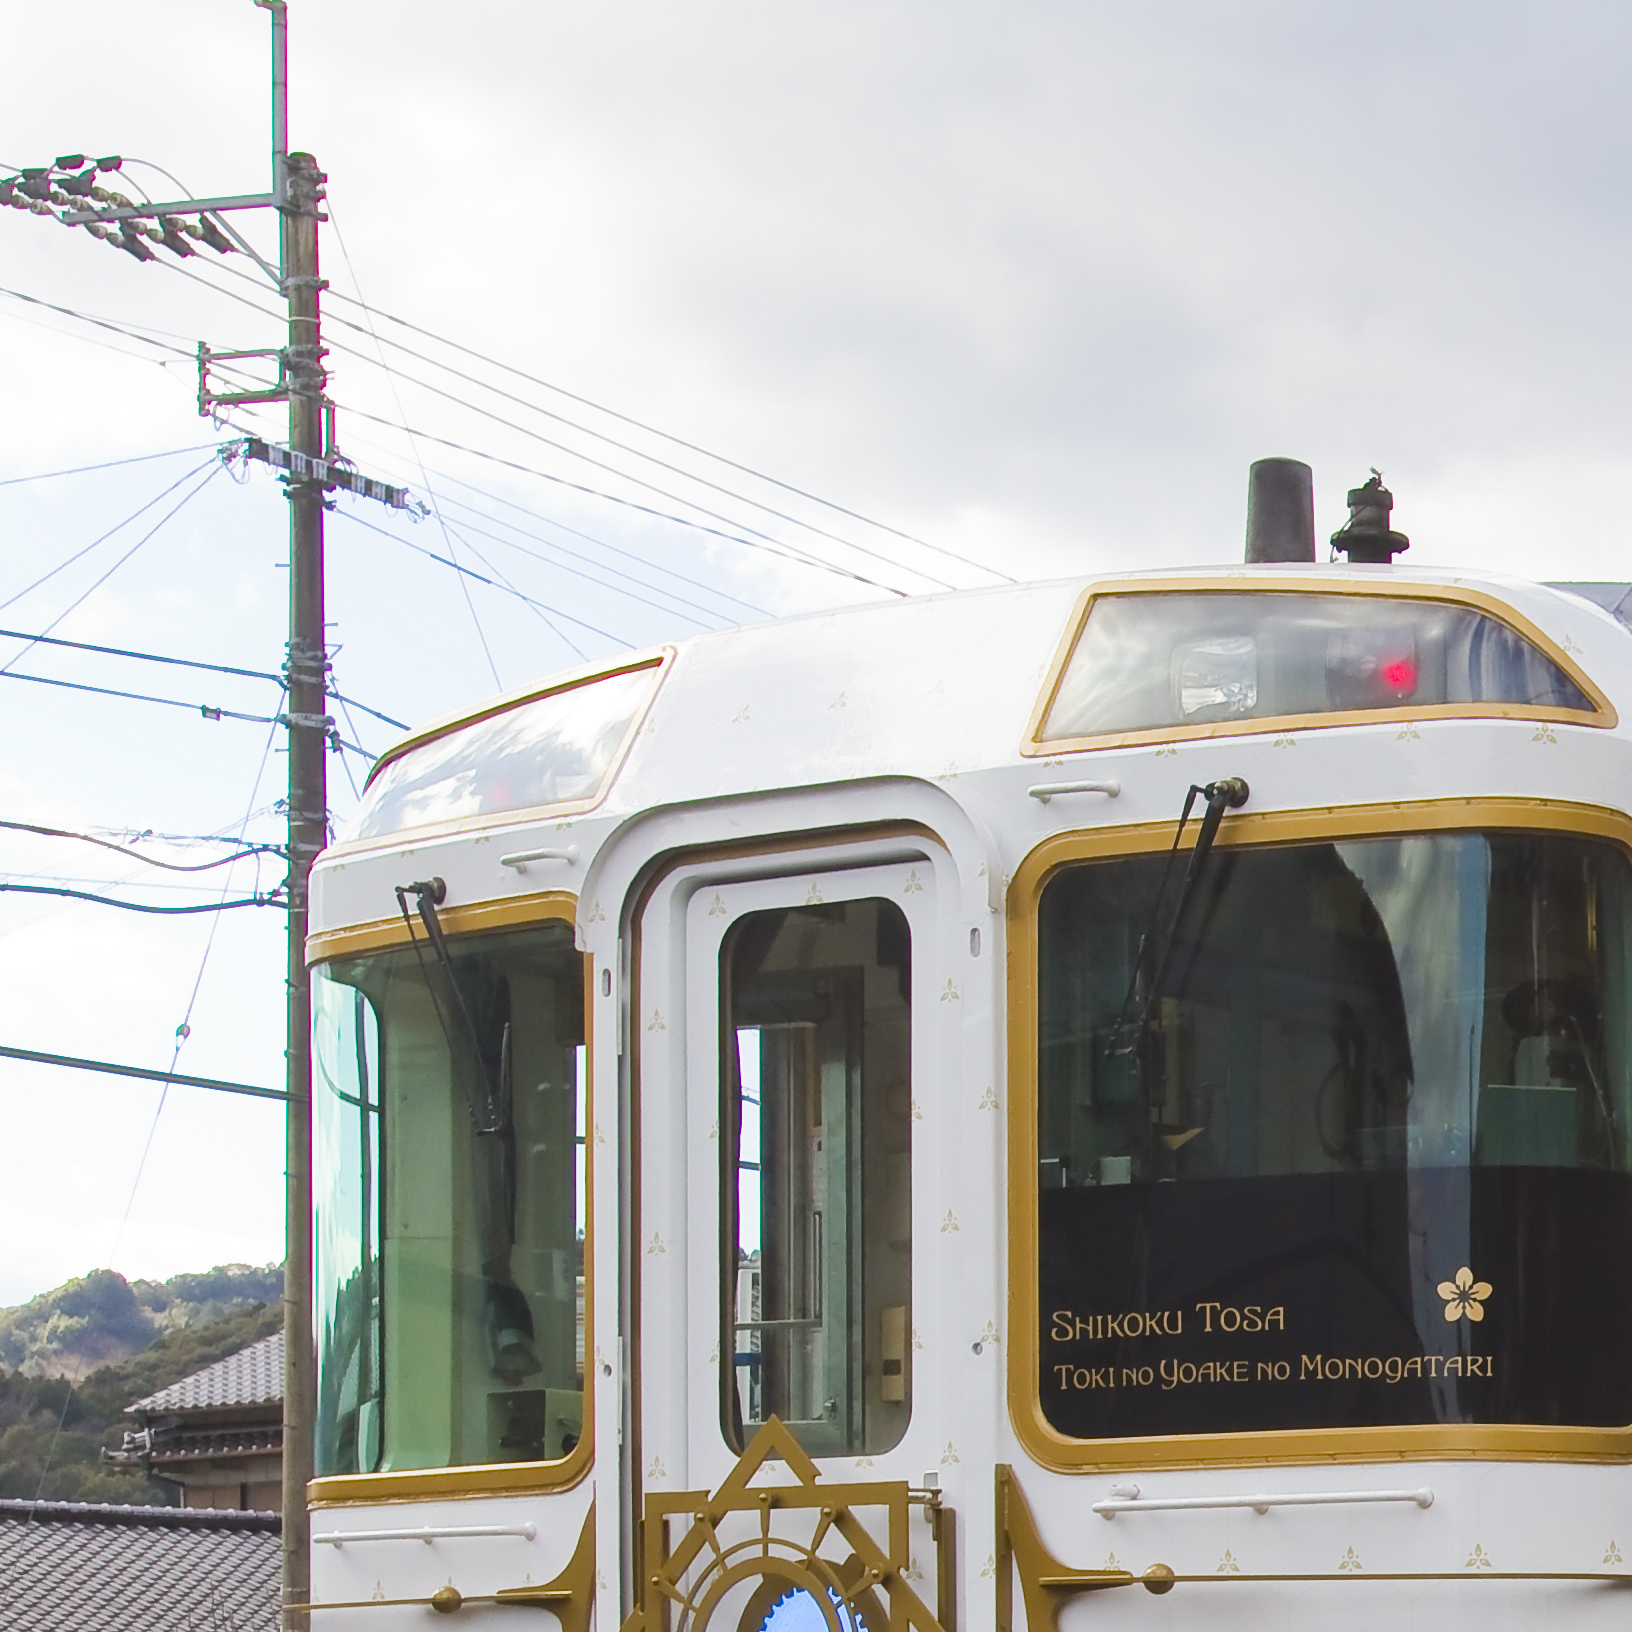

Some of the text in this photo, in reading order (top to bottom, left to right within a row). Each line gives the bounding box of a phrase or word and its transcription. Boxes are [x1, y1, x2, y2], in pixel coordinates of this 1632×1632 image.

[1050, 1302, 1286, 1342] SHIKOKU TOSA
[1053, 1364, 1116, 1390] TOKI
[1159, 1358, 1250, 1390] YOAKE
